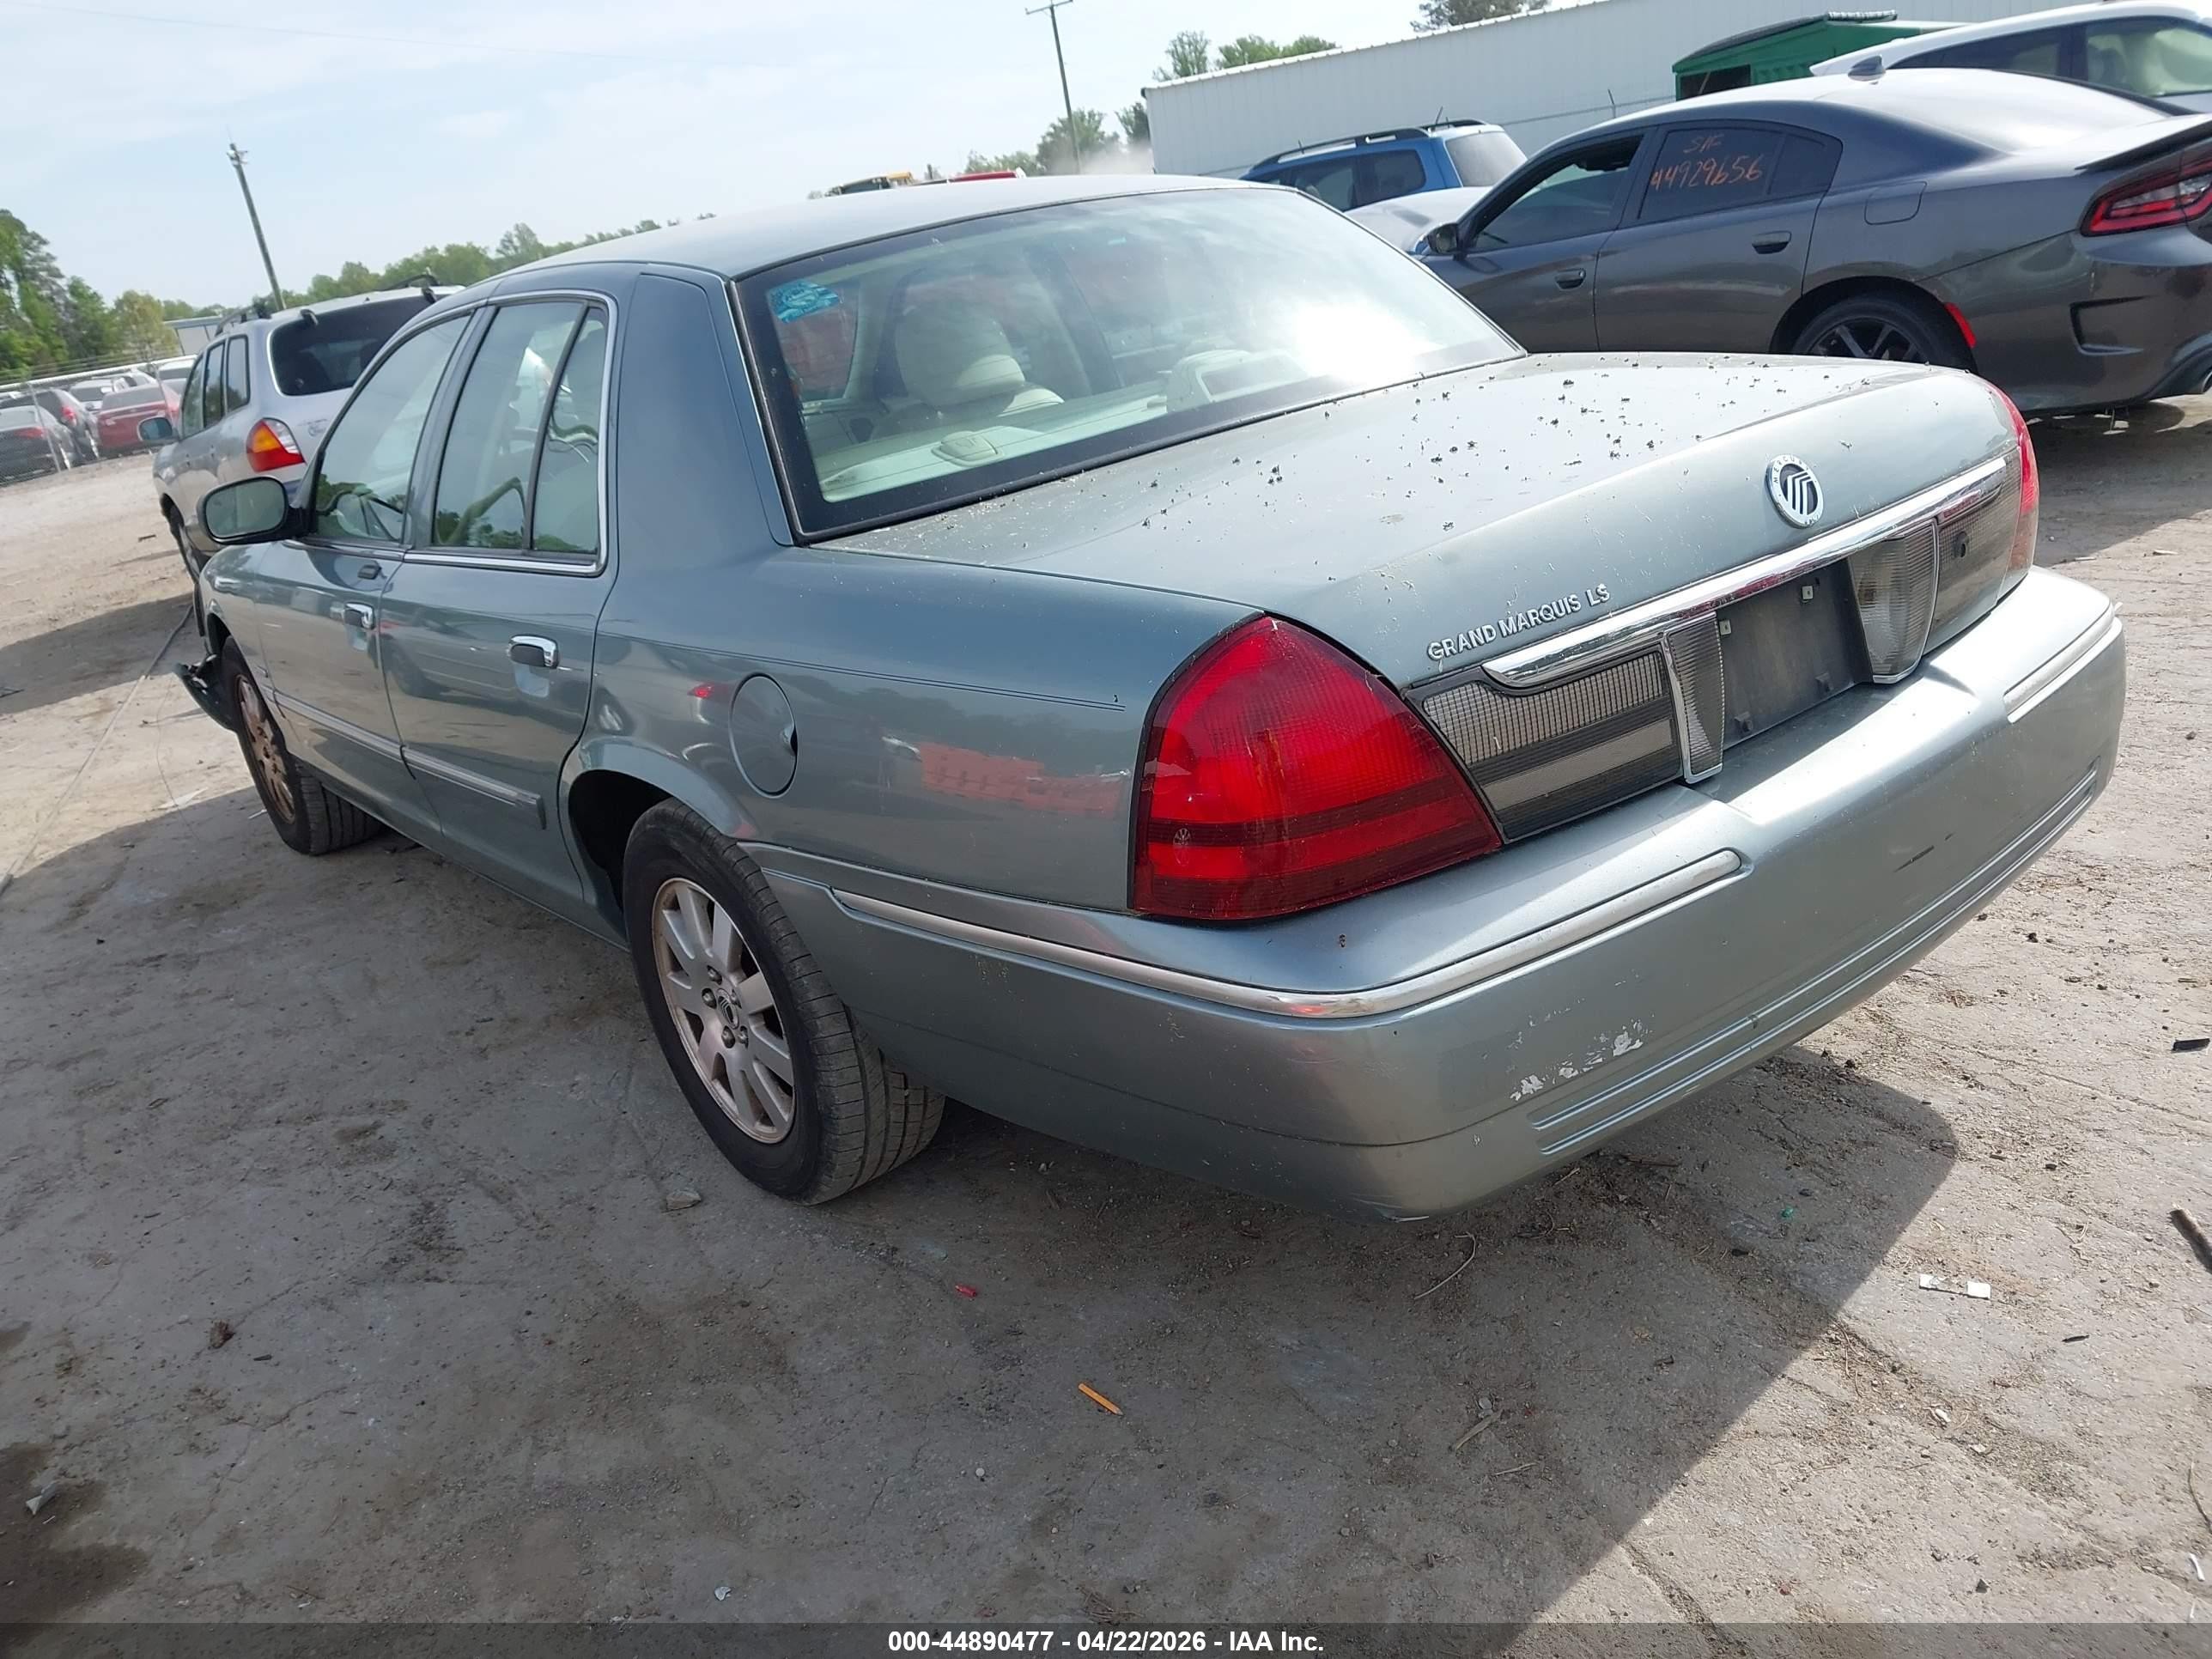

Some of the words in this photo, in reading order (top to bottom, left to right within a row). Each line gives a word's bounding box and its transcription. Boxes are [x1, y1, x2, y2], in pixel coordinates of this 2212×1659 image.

[1650, 155, 1764, 191] 44929656
[1427, 624, 1497, 660] GRAND
[1498, 593, 1582, 637] MARQUIS
[1585, 583, 1610, 606] LS
